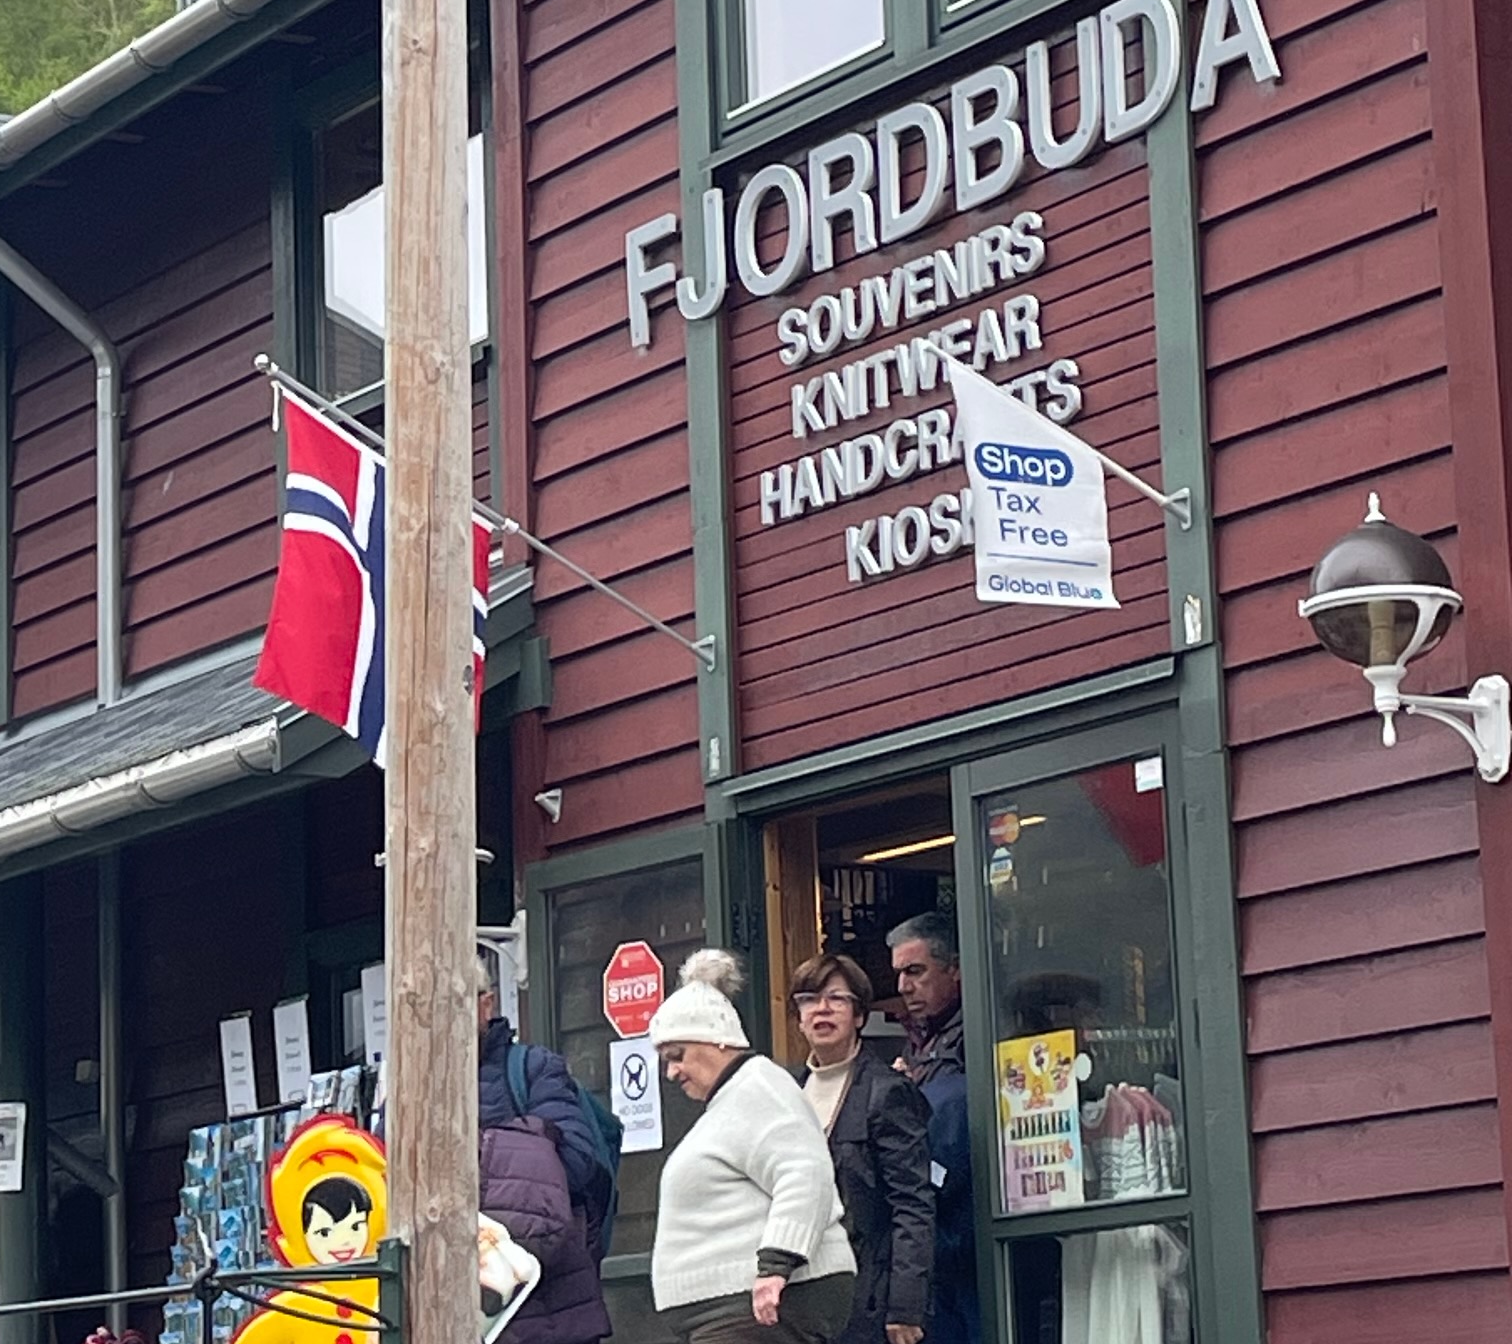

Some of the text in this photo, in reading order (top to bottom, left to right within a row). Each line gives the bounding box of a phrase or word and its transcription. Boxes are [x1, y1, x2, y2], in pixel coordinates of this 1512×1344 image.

[778, 212, 1045, 365] SOUVENIRS
[791, 294, 1042, 439] KNITWEAR
[981, 445, 1066, 486] Shop
[987, 486, 1043, 515] Tax
[999, 518, 1068, 547] Free
[989, 575, 1103, 600] Global Blue
[608, 981, 658, 1003] SHOP
